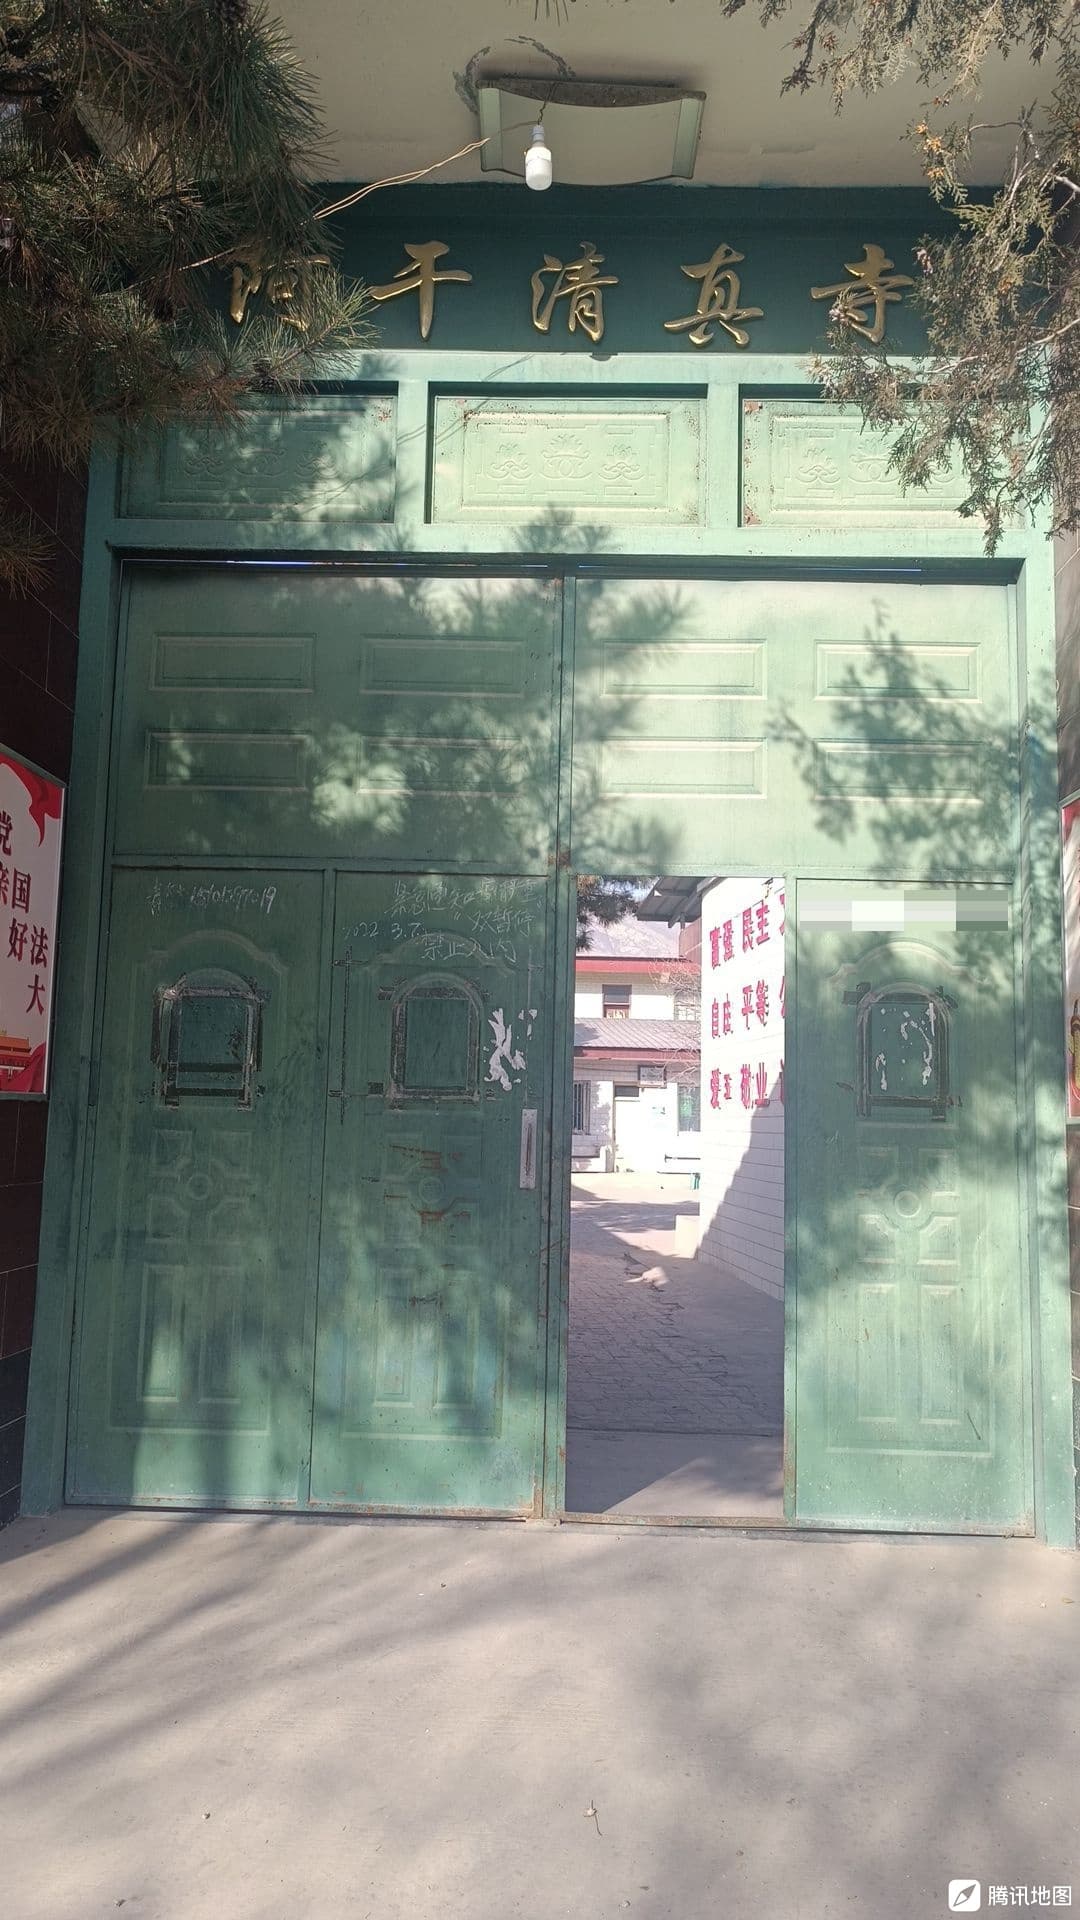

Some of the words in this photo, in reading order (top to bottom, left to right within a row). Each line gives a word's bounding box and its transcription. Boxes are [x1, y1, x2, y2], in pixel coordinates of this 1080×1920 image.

[741, 900, 770, 953] 民主
[711, 993, 732, 1039] 自由
[741, 979, 769, 1031] 平等
